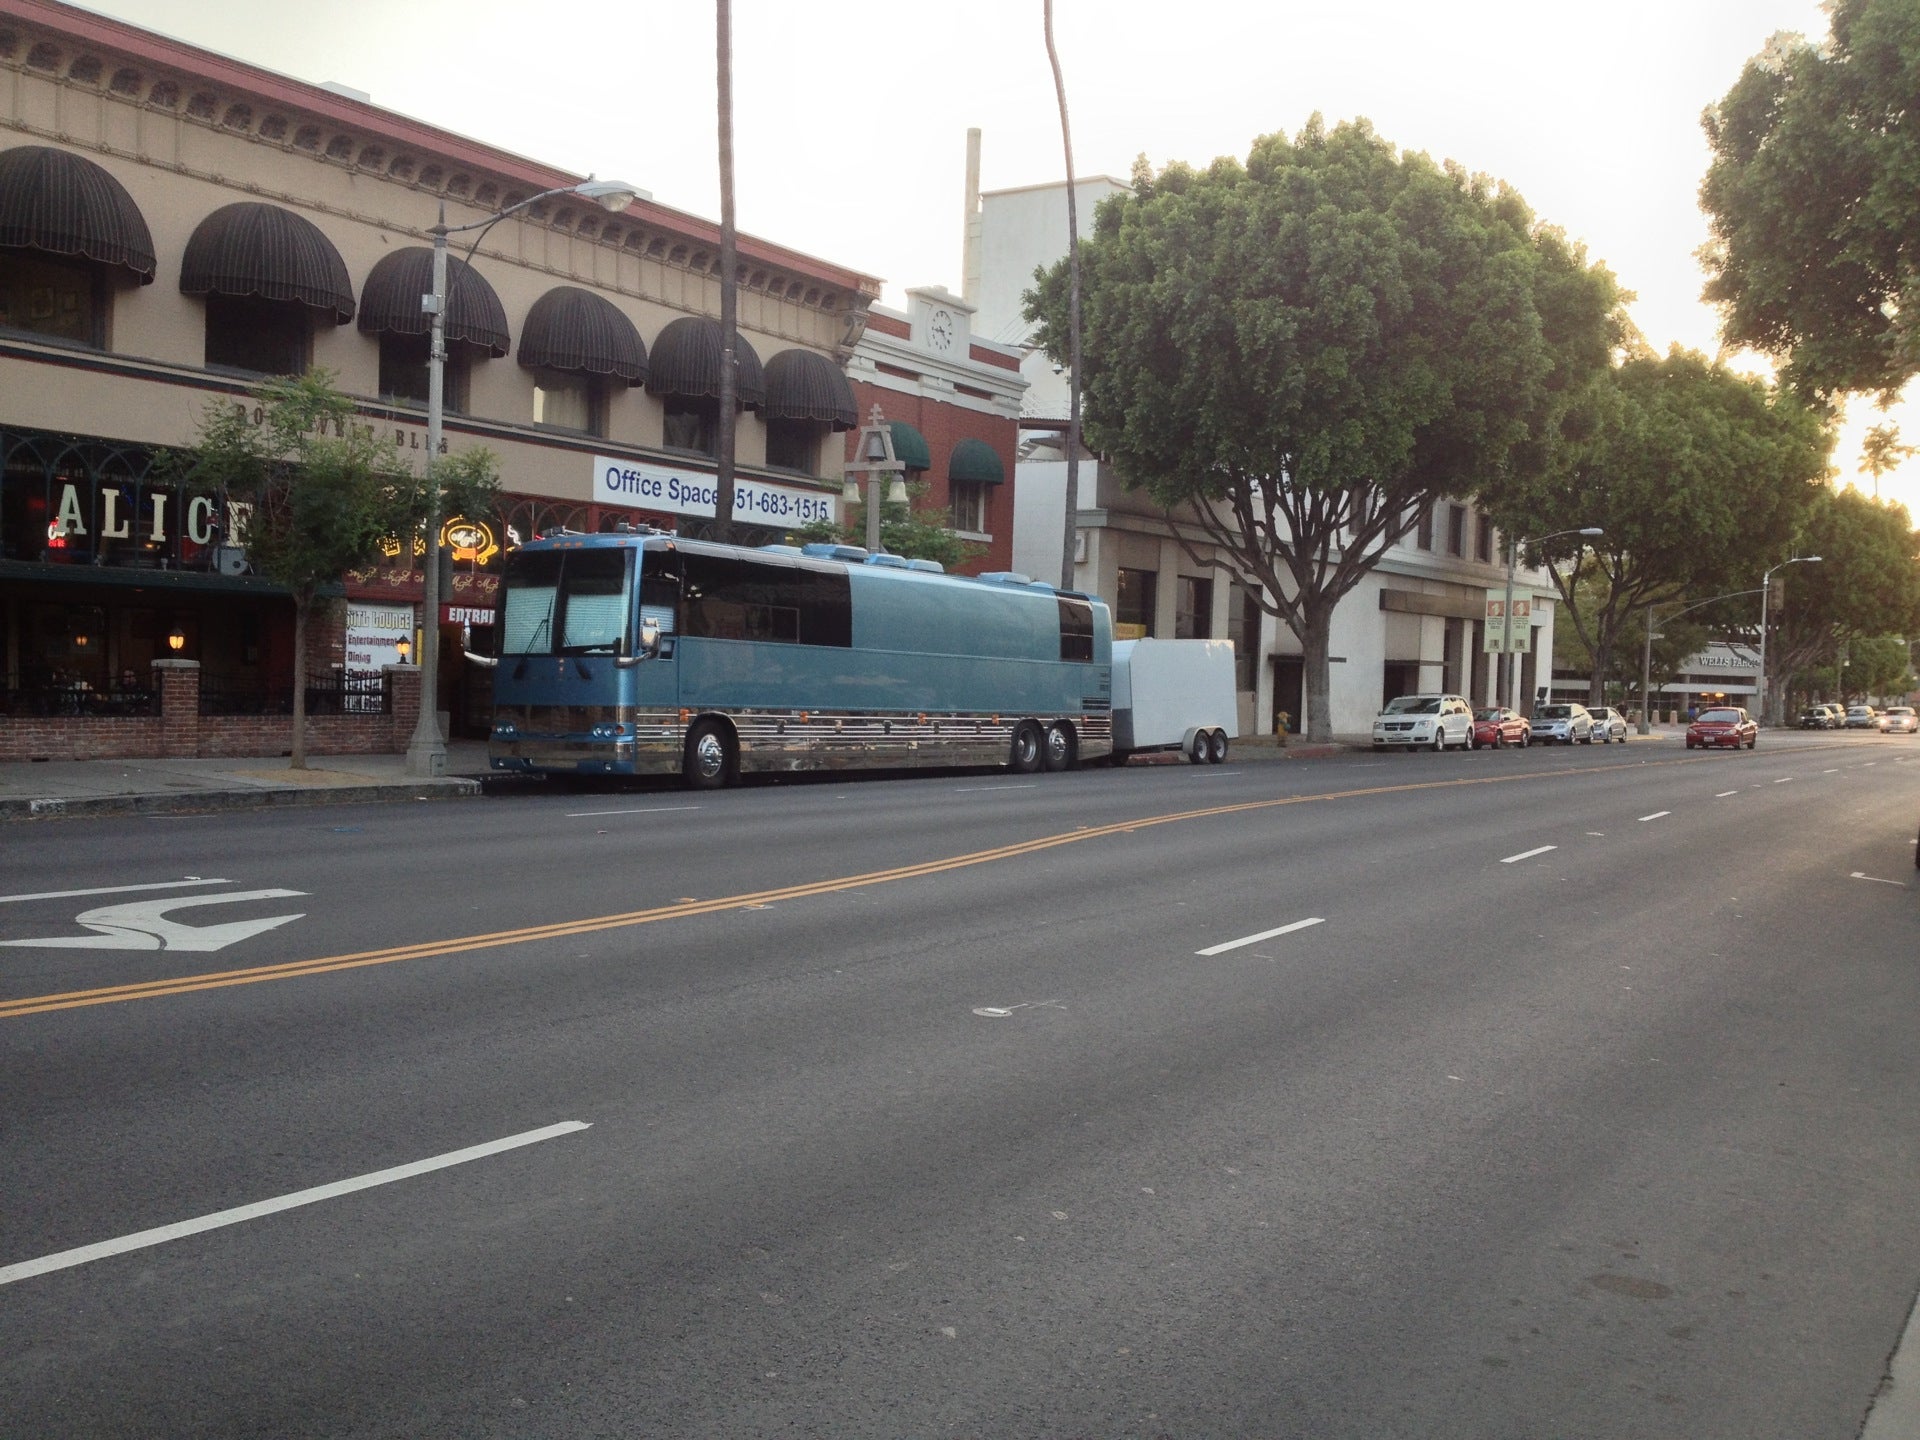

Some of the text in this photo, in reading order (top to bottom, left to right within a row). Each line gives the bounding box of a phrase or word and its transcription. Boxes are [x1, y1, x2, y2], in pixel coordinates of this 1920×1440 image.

[605, 467, 828, 521] Office Space 51-683-1515
[371, 611, 411, 630] LOUNGE
[348, 634, 397, 648] Entertainment
[348, 651, 371, 665] Dining
[1700, 656, 1729, 667] WELLS
